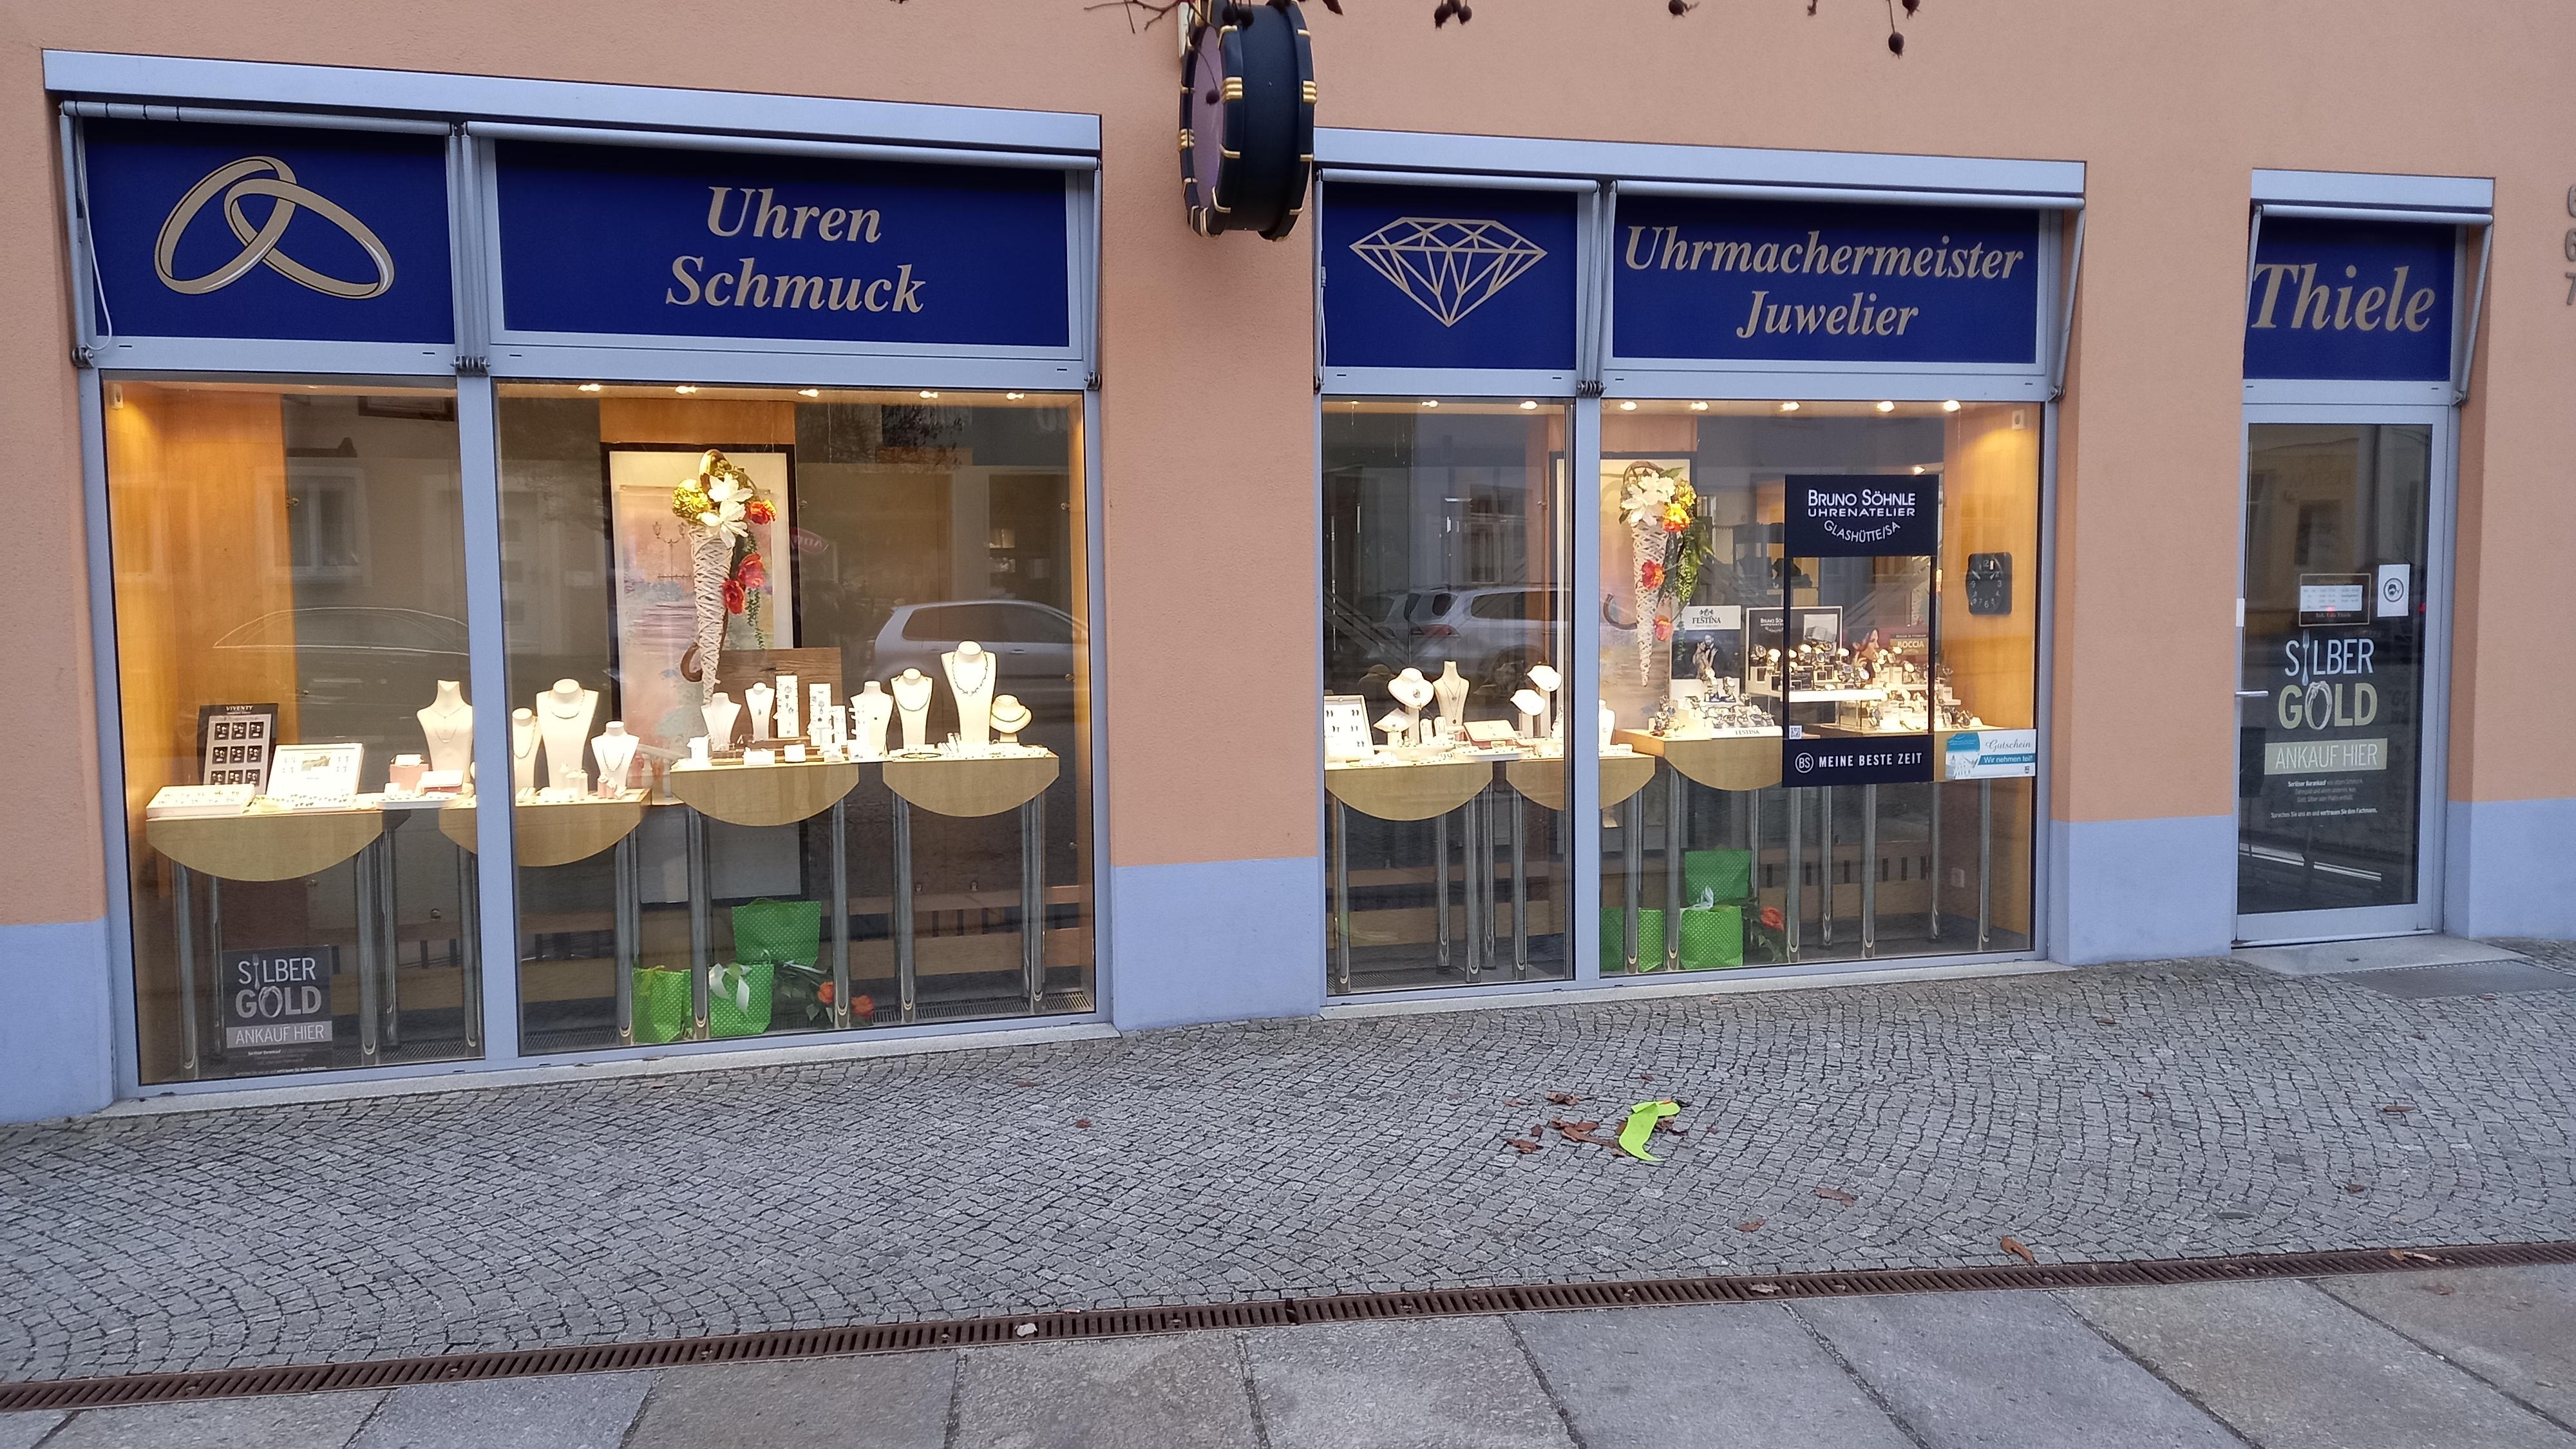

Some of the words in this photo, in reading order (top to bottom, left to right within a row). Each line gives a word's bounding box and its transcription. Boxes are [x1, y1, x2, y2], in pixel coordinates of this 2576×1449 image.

[708, 186, 881, 243] Uhren
[1625, 226, 2024, 279] Uhrmachermeister
[666, 256, 926, 313] Schmuck
[2251, 263, 2436, 332] Thiele
[1736, 290, 1918, 339] Juwelier
[1808, 489, 1857, 506] BRUNO
[1862, 489, 1916, 506] SÖHNLE
[1808, 507, 1915, 517] UHRENATELIER
[1824, 520, 1900, 543] GLASHÜTTE/SA
[2285, 630, 2374, 686] SILBER
[2278, 681, 2378, 730] GOLD
[1819, 755, 1853, 768] MEINE
[1859, 753, 1893, 766] BESTE
[1898, 752, 1922, 764] ZEIT
[1985, 739, 2031, 752] Gutschein
[2275, 745, 2339, 770] ANKAUF
[2343, 744, 2378, 766] HIER
[238, 954, 316, 990] SILBER
[236, 986, 321, 1018] GOLD
[236, 1027, 290, 1045] ANKAUF
[294, 1025, 324, 1040] HIER
